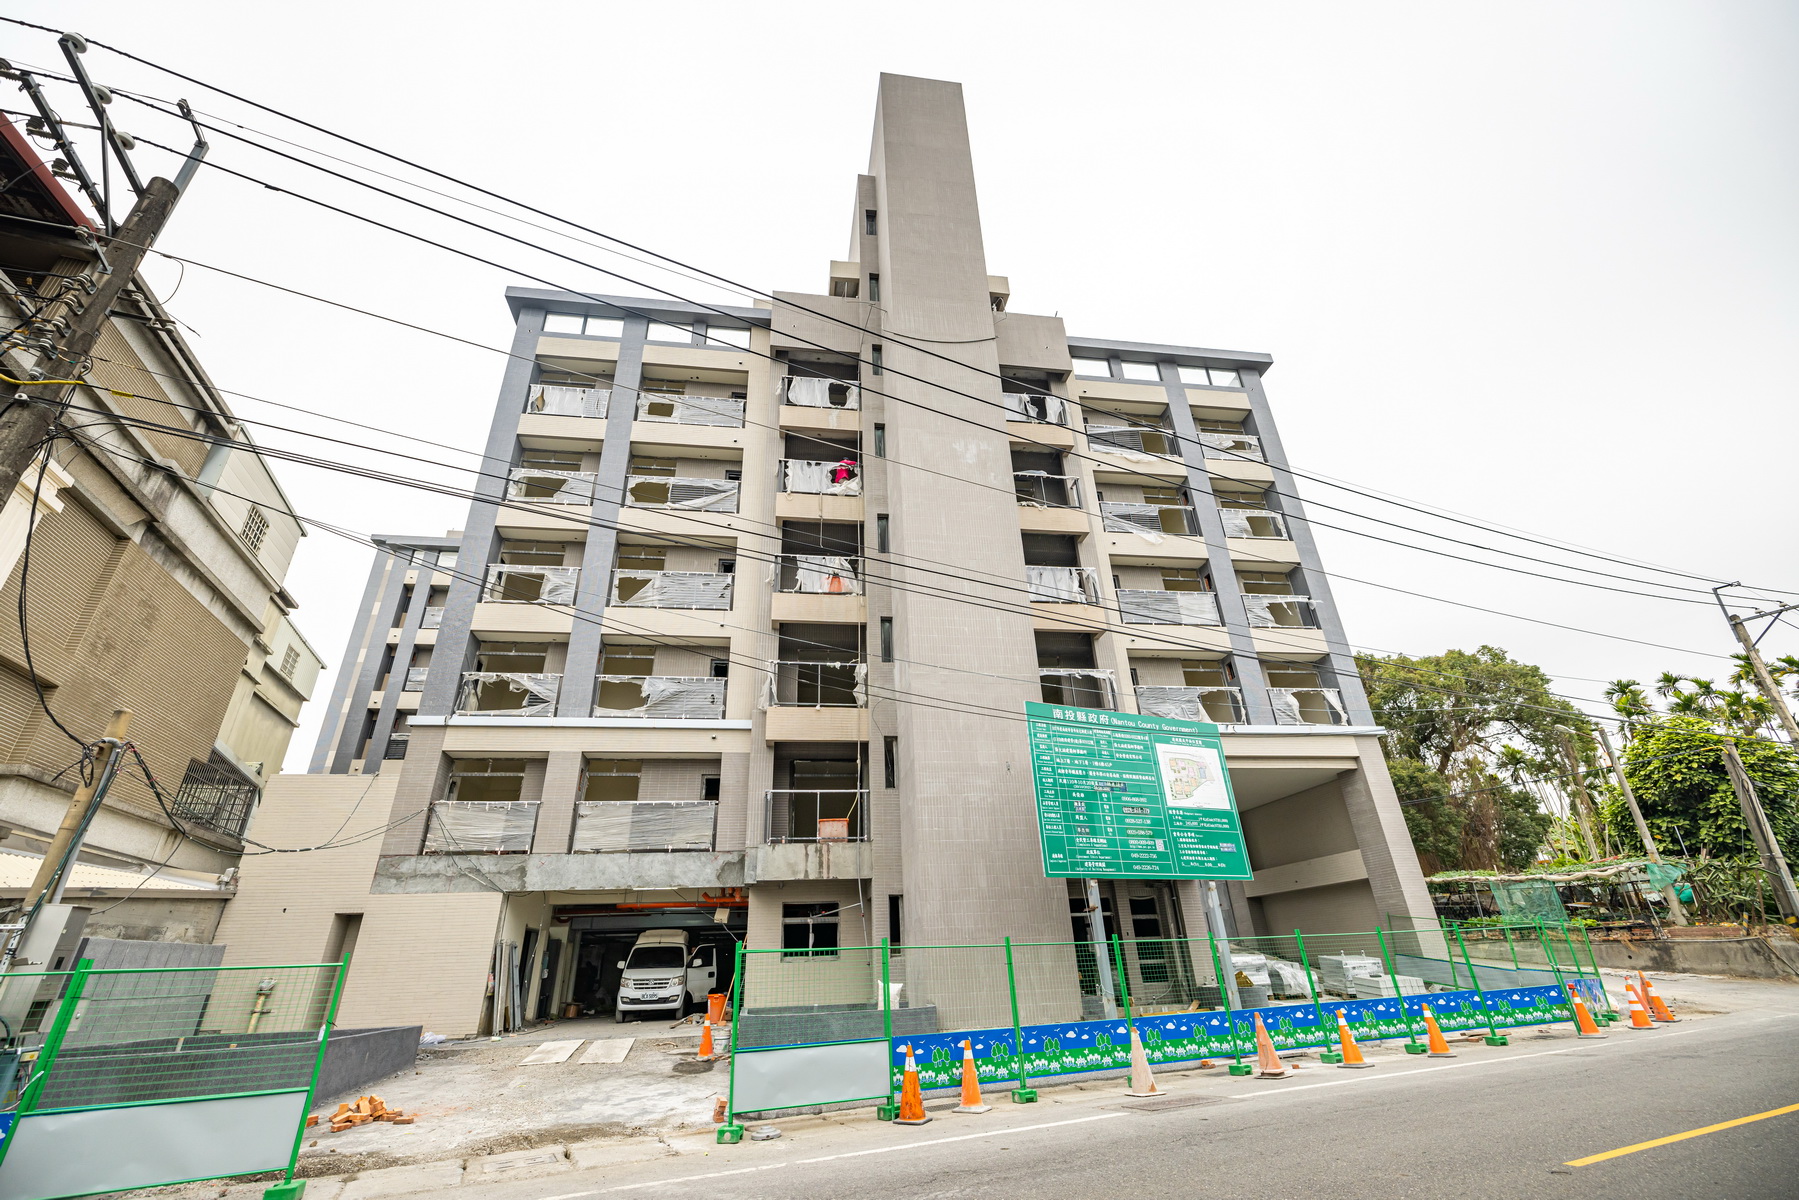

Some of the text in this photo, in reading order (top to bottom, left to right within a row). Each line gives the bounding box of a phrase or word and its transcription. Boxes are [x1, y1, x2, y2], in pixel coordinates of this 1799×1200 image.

[1053, 709, 1109, 725] 南投縣政府
[1110, 717, 1199, 733] (Nantou County Government)
